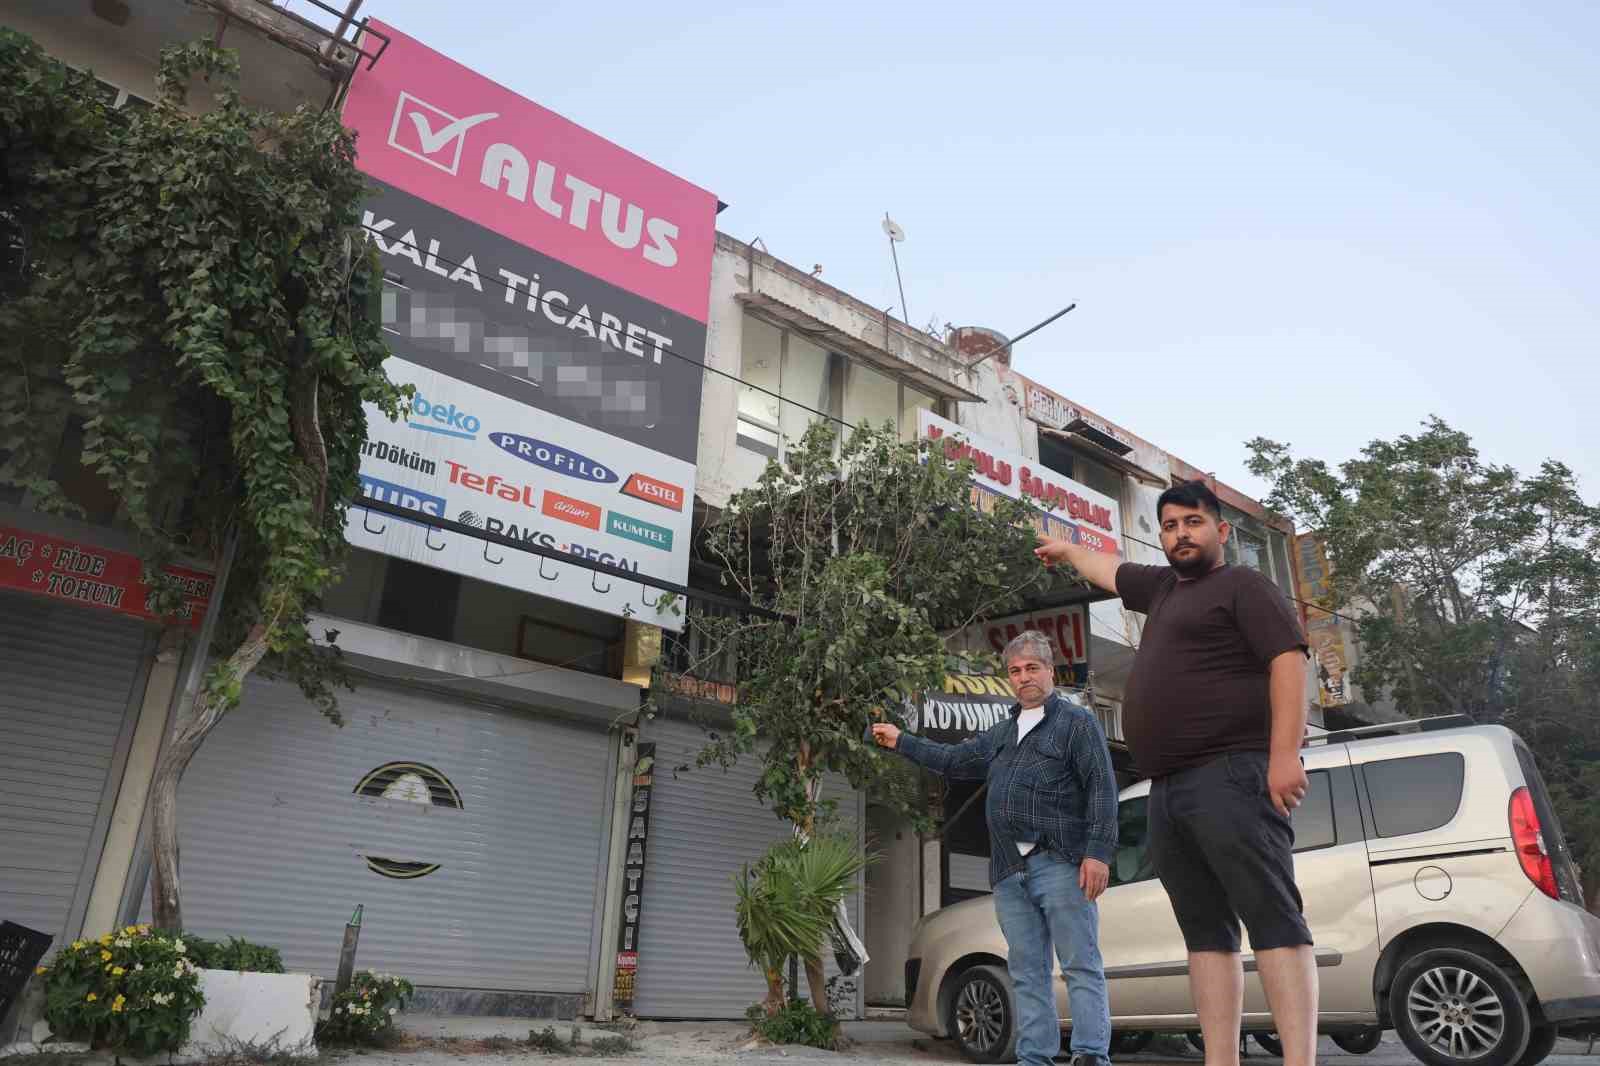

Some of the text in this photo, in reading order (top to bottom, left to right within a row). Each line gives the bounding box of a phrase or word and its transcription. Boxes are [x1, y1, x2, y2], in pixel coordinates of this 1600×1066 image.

[480, 143, 679, 267] ALTUS
[361, 210, 483, 291] KALA
[499, 268, 672, 364] TİCARET
[412, 391, 481, 433] beko
[445, 460, 536, 508] Tefal
[636, 479, 678, 503] VESTEL
[486, 517, 556, 551] RAKS
[612, 519, 666, 542] KUMTEL
[0, 536, 106, 577] AÇ FİDE
[48, 573, 127, 608] TOHUM
